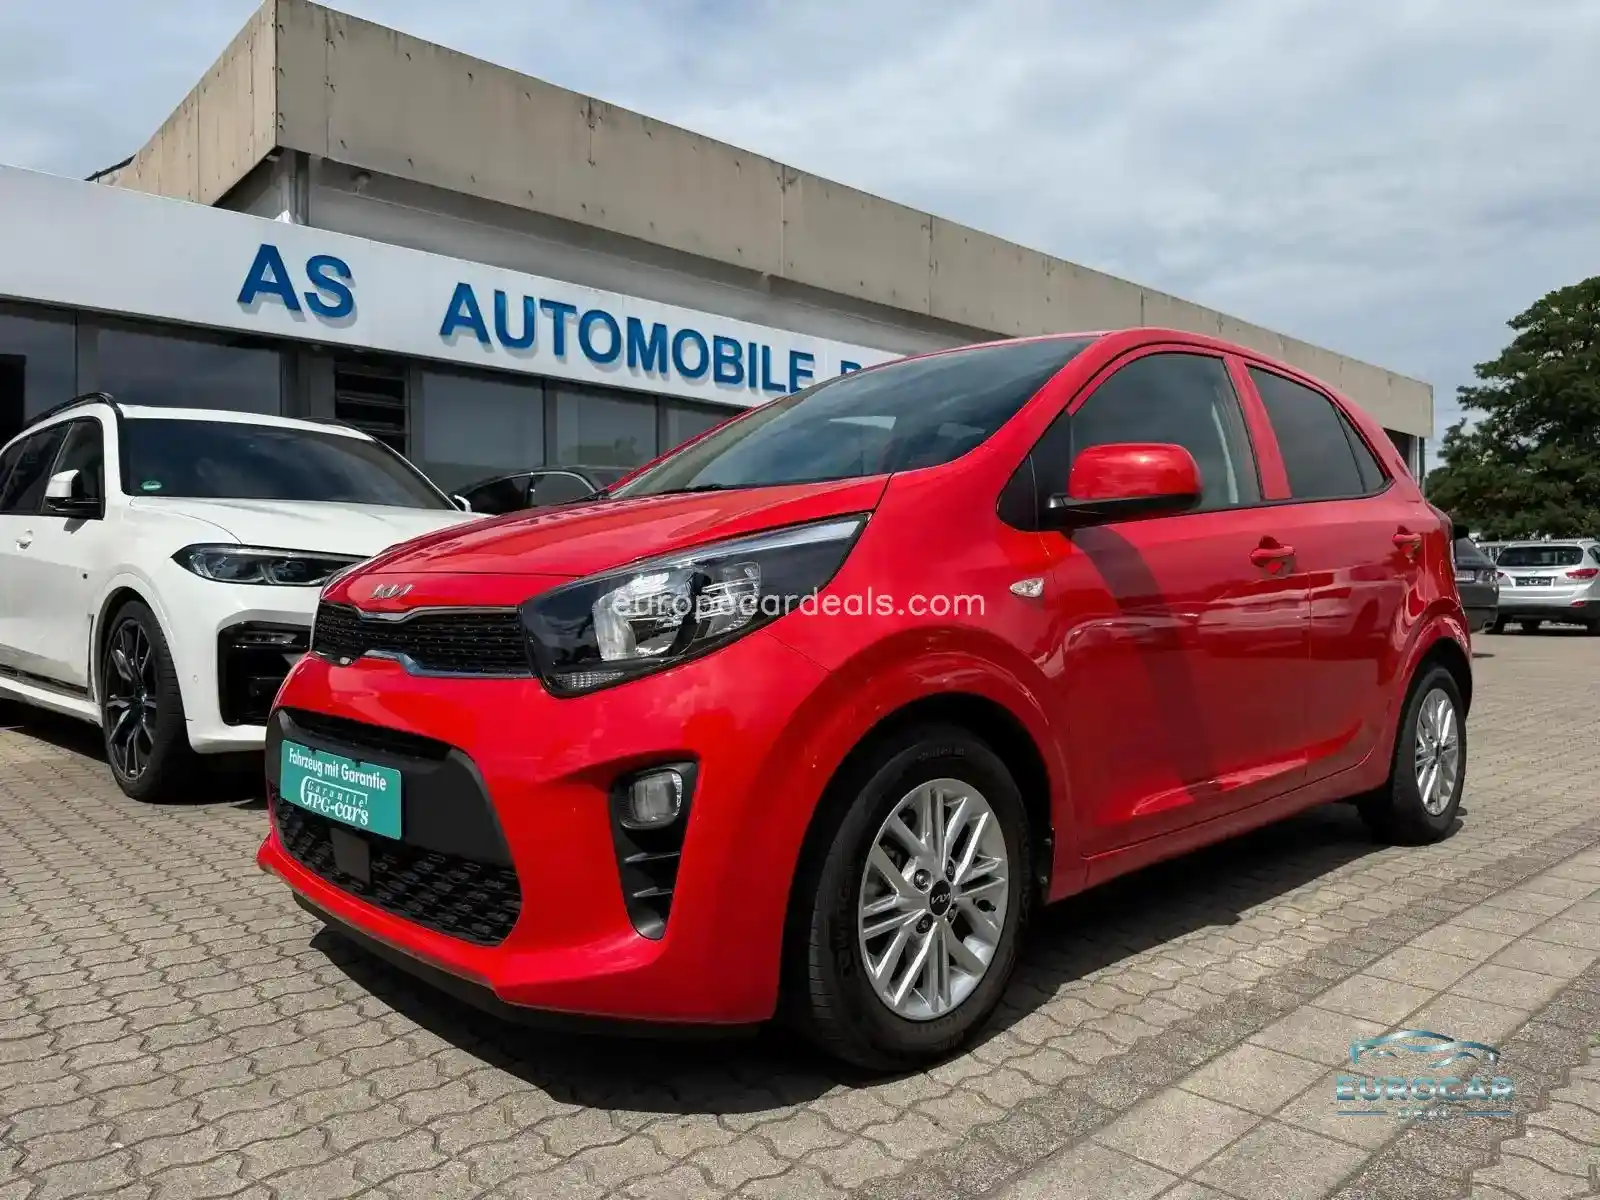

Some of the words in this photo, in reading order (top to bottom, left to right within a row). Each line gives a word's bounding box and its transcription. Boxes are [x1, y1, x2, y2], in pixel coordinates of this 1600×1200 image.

[237, 243, 354, 318] AS
[439, 282, 815, 394] AUTOMOBILE
[288, 747, 323, 777] Fahrzeug
[324, 761, 339, 778] mit
[341, 763, 387, 791] Garantie
[307, 780, 364, 807] Garantie
